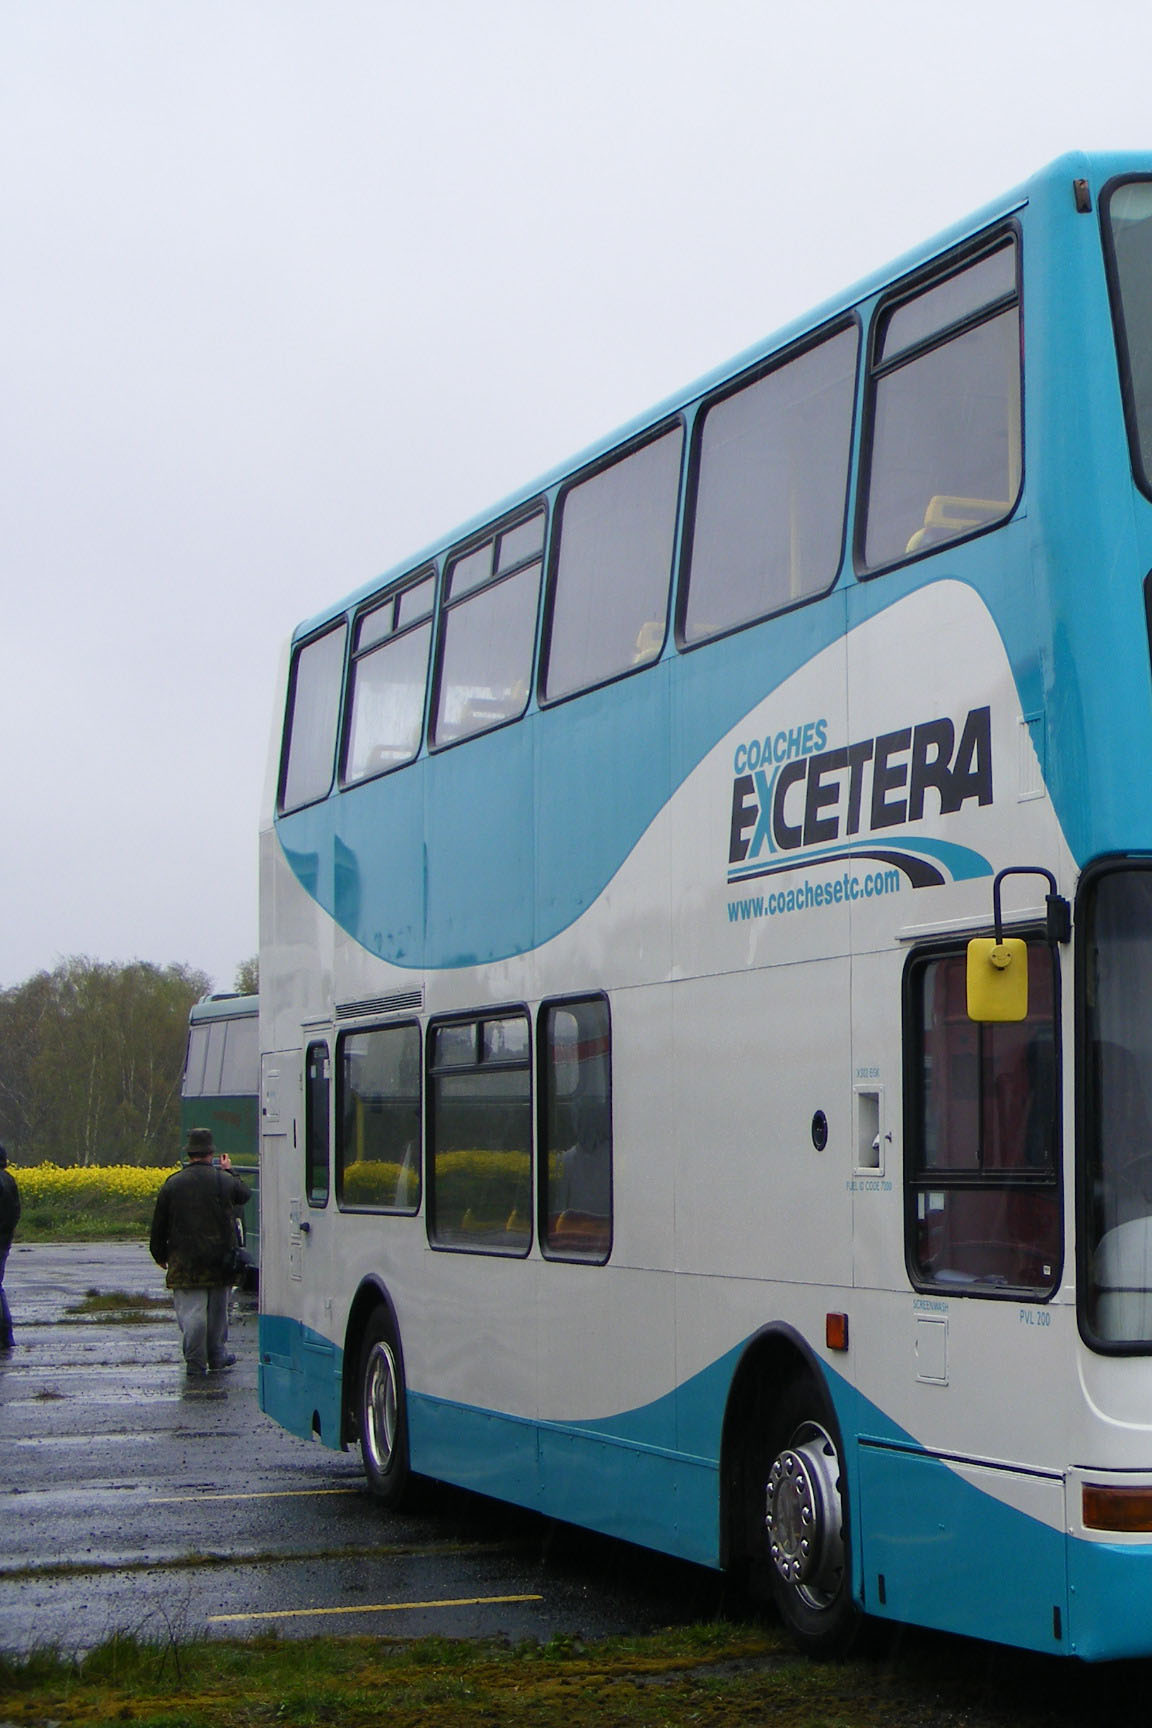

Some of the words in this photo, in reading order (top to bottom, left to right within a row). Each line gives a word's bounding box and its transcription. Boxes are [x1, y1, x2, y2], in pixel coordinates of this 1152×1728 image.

[734, 719, 828, 775] COACHES
[729, 705, 993, 864] EXCETERA
[727, 869, 900, 922] www.coachesetc.com
[913, 1299, 949, 1312] SCREENWASH
[1020, 1309, 1034, 1325] PVL
[1037, 1311, 1050, 1327] 200
